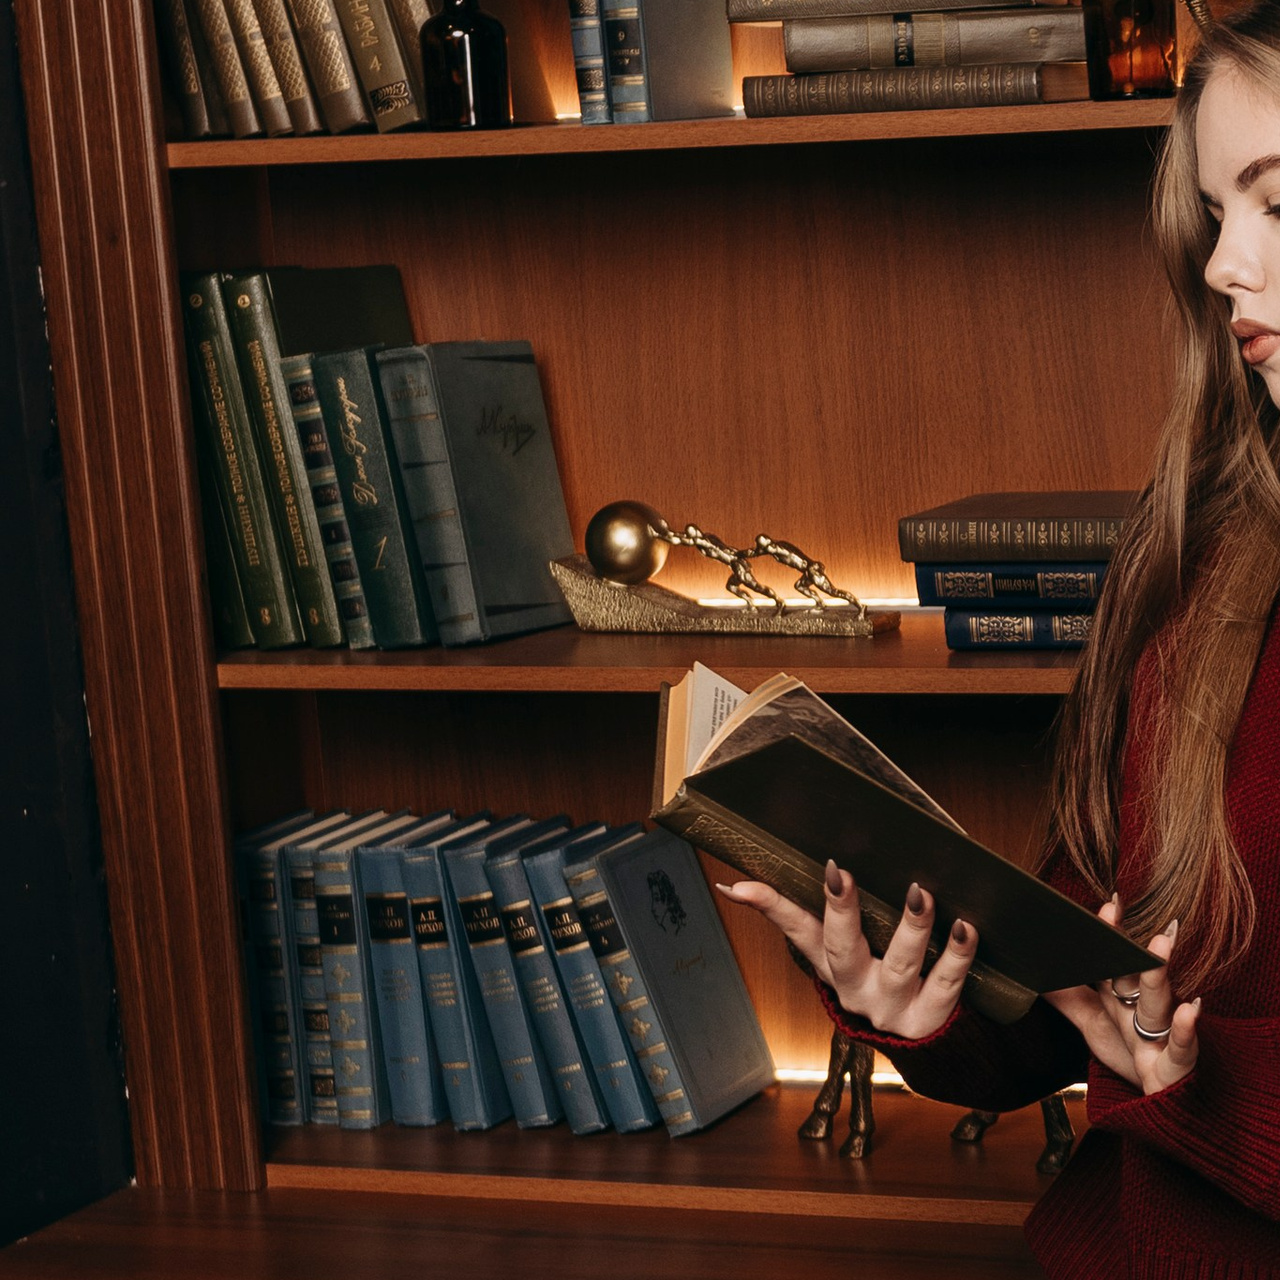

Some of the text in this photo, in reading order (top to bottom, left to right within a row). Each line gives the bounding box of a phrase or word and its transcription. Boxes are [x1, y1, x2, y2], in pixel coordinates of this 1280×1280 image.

[365, 53, 383, 73] 4
[953, 82, 967, 90] 3
[198, 338, 261, 567] ПУШКИН ПОЛНОЕ СОБРАНИЕ СОЧИНЕНИЙ
[246, 338, 310, 568] ПУШКИН ПОЛНОЕ СОБРАНИЕ СОЧИНЕНИЙ
[350, 452, 379, 507] Джон
